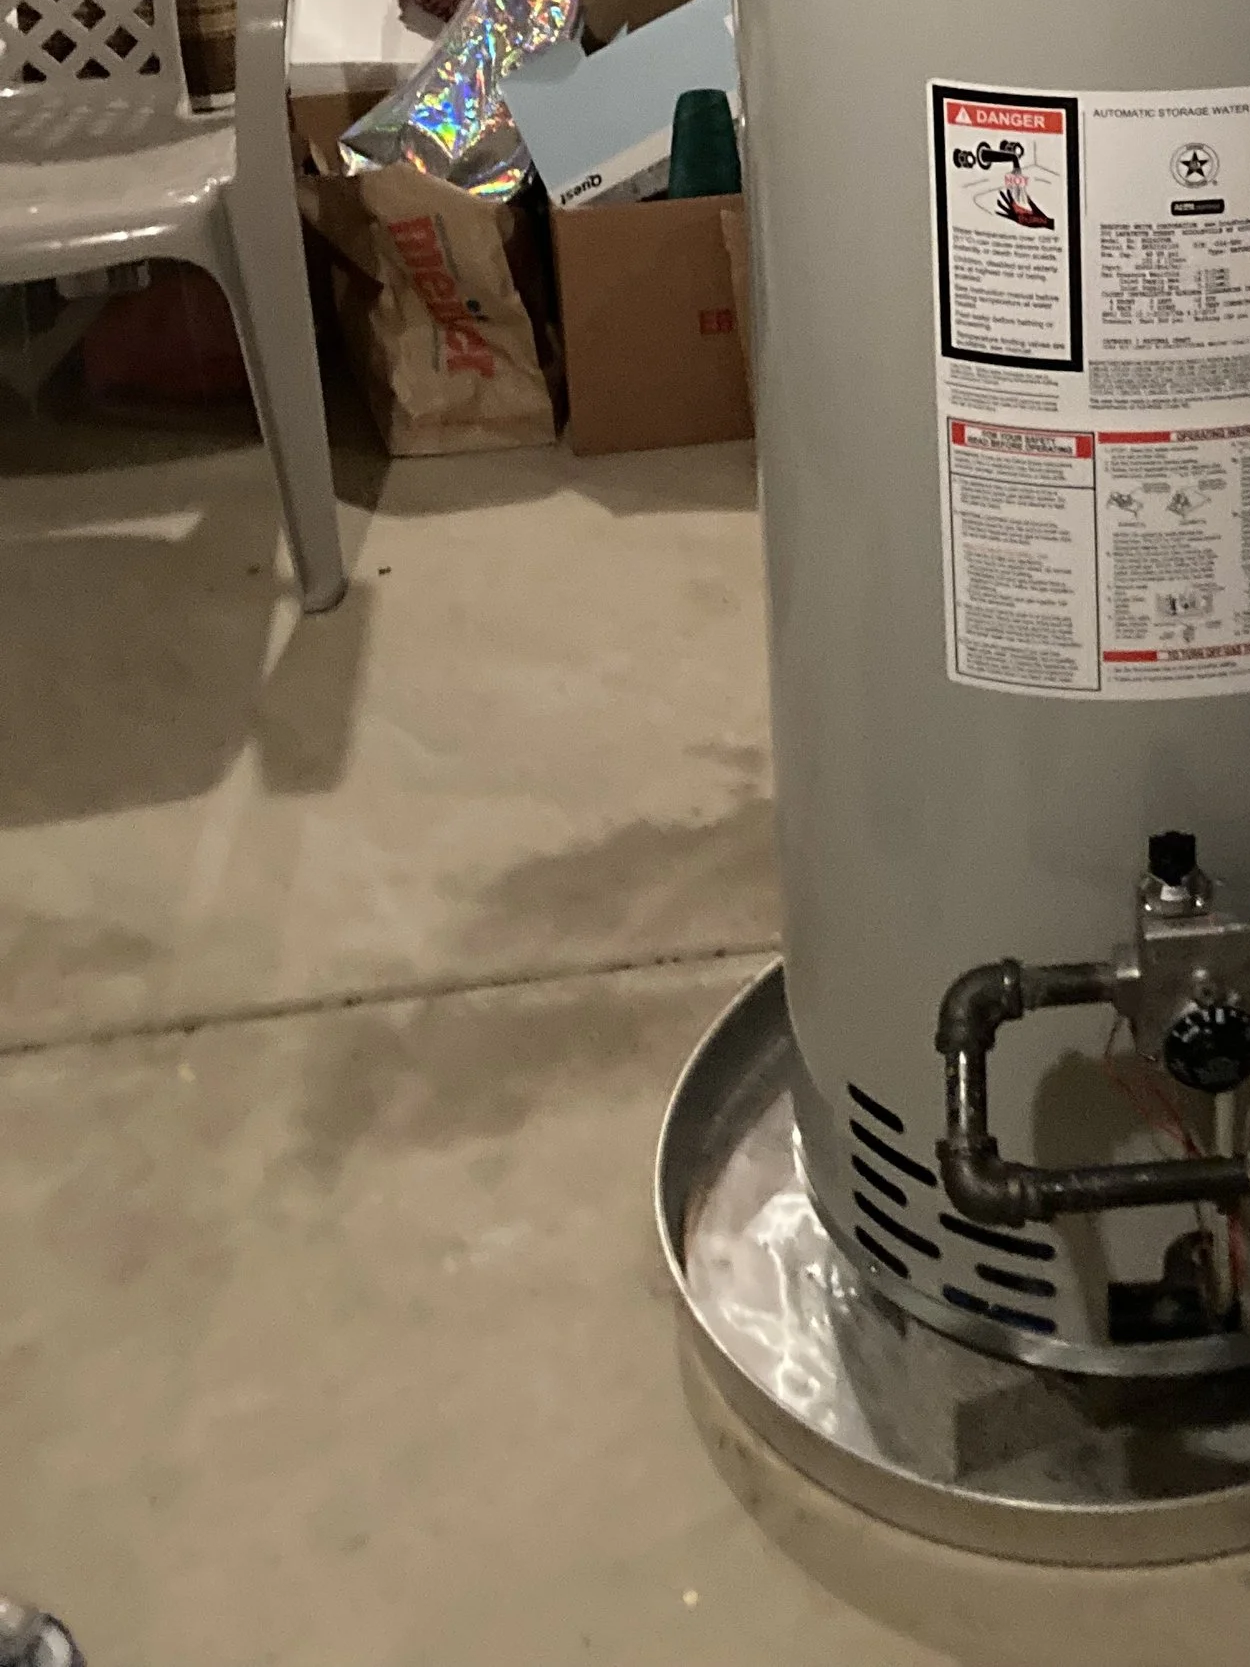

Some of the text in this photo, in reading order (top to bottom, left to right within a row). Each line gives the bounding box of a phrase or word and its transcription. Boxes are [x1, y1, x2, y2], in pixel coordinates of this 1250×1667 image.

[976, 109, 1046, 129] DANGER
[1092, 108, 1155, 118] AUTOMATIC
[1158, 106, 1208, 118] STORAGE
[1212, 104, 1250, 115] WATER
